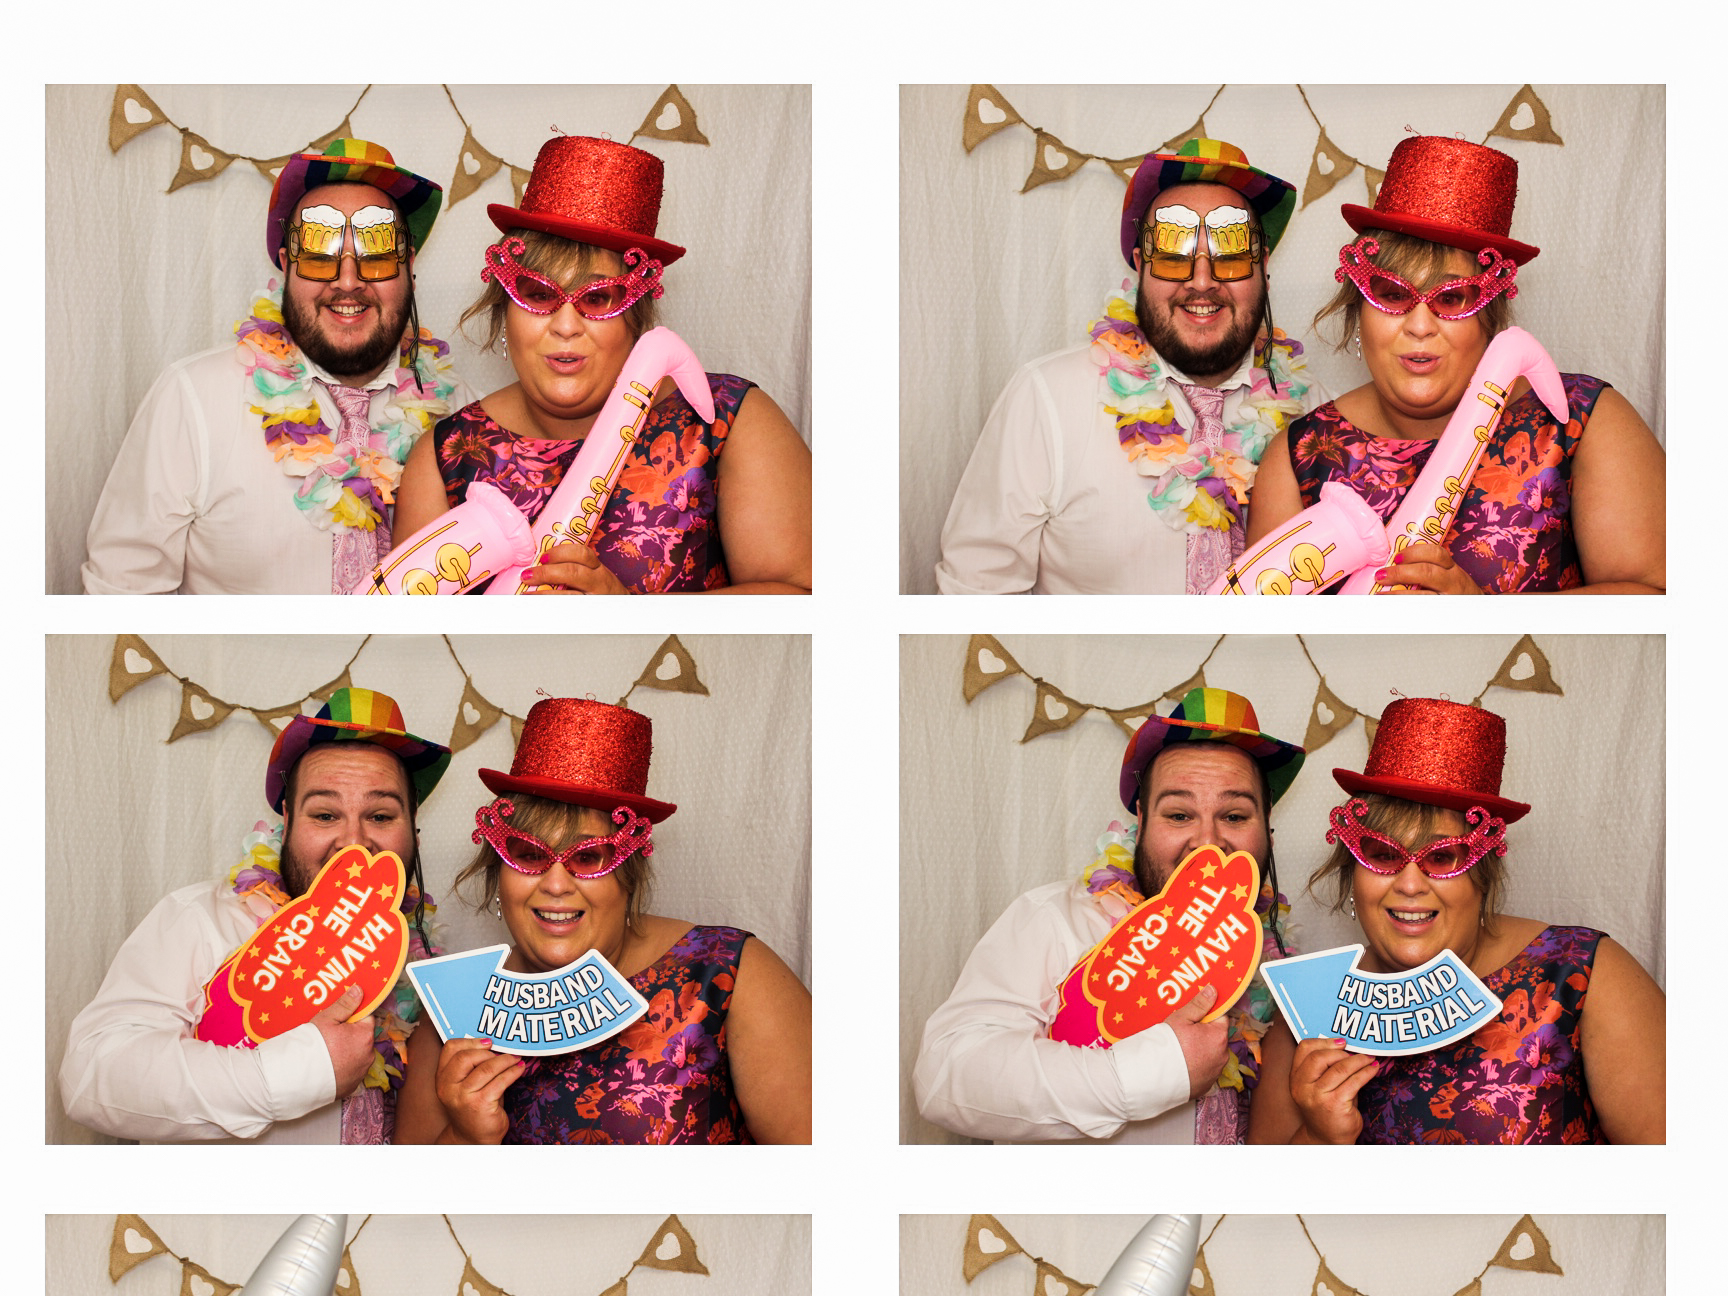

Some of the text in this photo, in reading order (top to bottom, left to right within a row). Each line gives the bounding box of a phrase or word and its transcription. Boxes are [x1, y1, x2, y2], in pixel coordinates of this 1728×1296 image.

[322, 885, 373, 938] THE
[1176, 885, 1227, 938] THE
[253, 914, 314, 992] CRAIC
[303, 913, 395, 1005] HAVING
[1107, 914, 1168, 992] CRAIC
[1157, 913, 1249, 1005] HAVING
[484, 964, 604, 1009] HUSBAND
[1338, 964, 1458, 1009] HUSBAND
[477, 987, 632, 1043] MATERIAL
[1331, 987, 1486, 1043] MATERIAL
